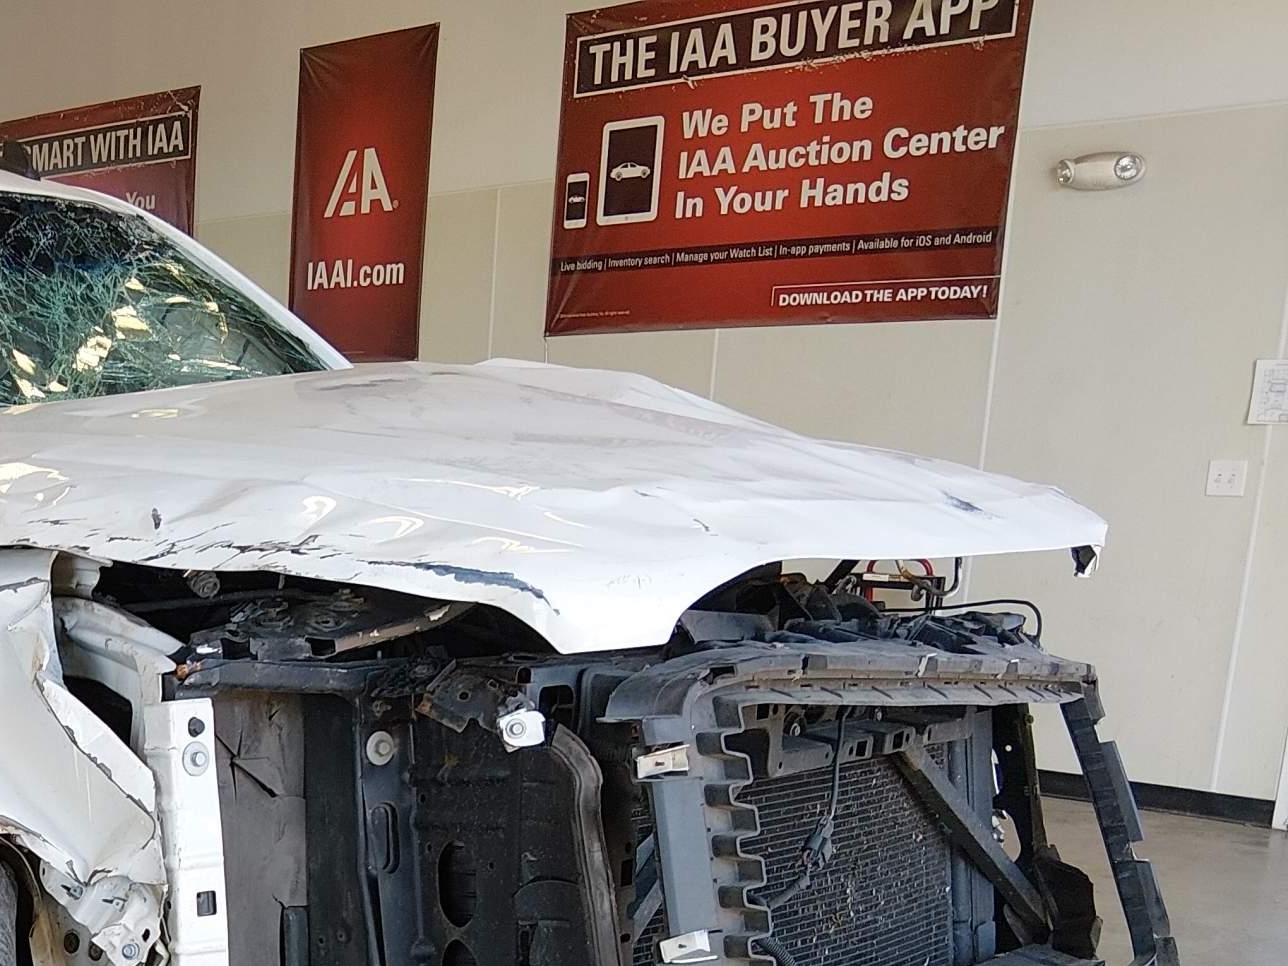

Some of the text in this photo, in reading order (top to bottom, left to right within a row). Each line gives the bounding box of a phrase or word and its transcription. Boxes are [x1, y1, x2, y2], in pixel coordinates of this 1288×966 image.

[589, 0, 1000, 85] THE IAA BUYER APP
[682, 92, 873, 139] We Put The
[23, 136, 86, 172] MART
[89, 127, 141, 164] WITH
[147, 121, 184, 155] IAA
[678, 124, 1006, 179] IAA Auction Center
[674, 172, 910, 219] In Your Hands
[307, 258, 405, 290] IAAI.com
[560, 261, 575, 272] Live
[577, 259, 602, 271] bidding
[608, 256, 643, 269] Inventory
[644, 253, 670, 265] search
[676, 252, 708, 263] Manage
[710, 251, 728, 262] your
[729, 246, 756, 258] Watch
[758, 245, 772, 257] List
[779, 244, 806, 256] In-app
[808, 242, 850, 255] payments
[857, 238, 898, 250] Available
[900, 237, 913, 248] for
[915, 235, 932, 247] iOS
[934, 235, 952, 246] and
[953, 231, 993, 245] Android
[778, 285, 988, 307] DOWNLOAD THE APP TODAY!
